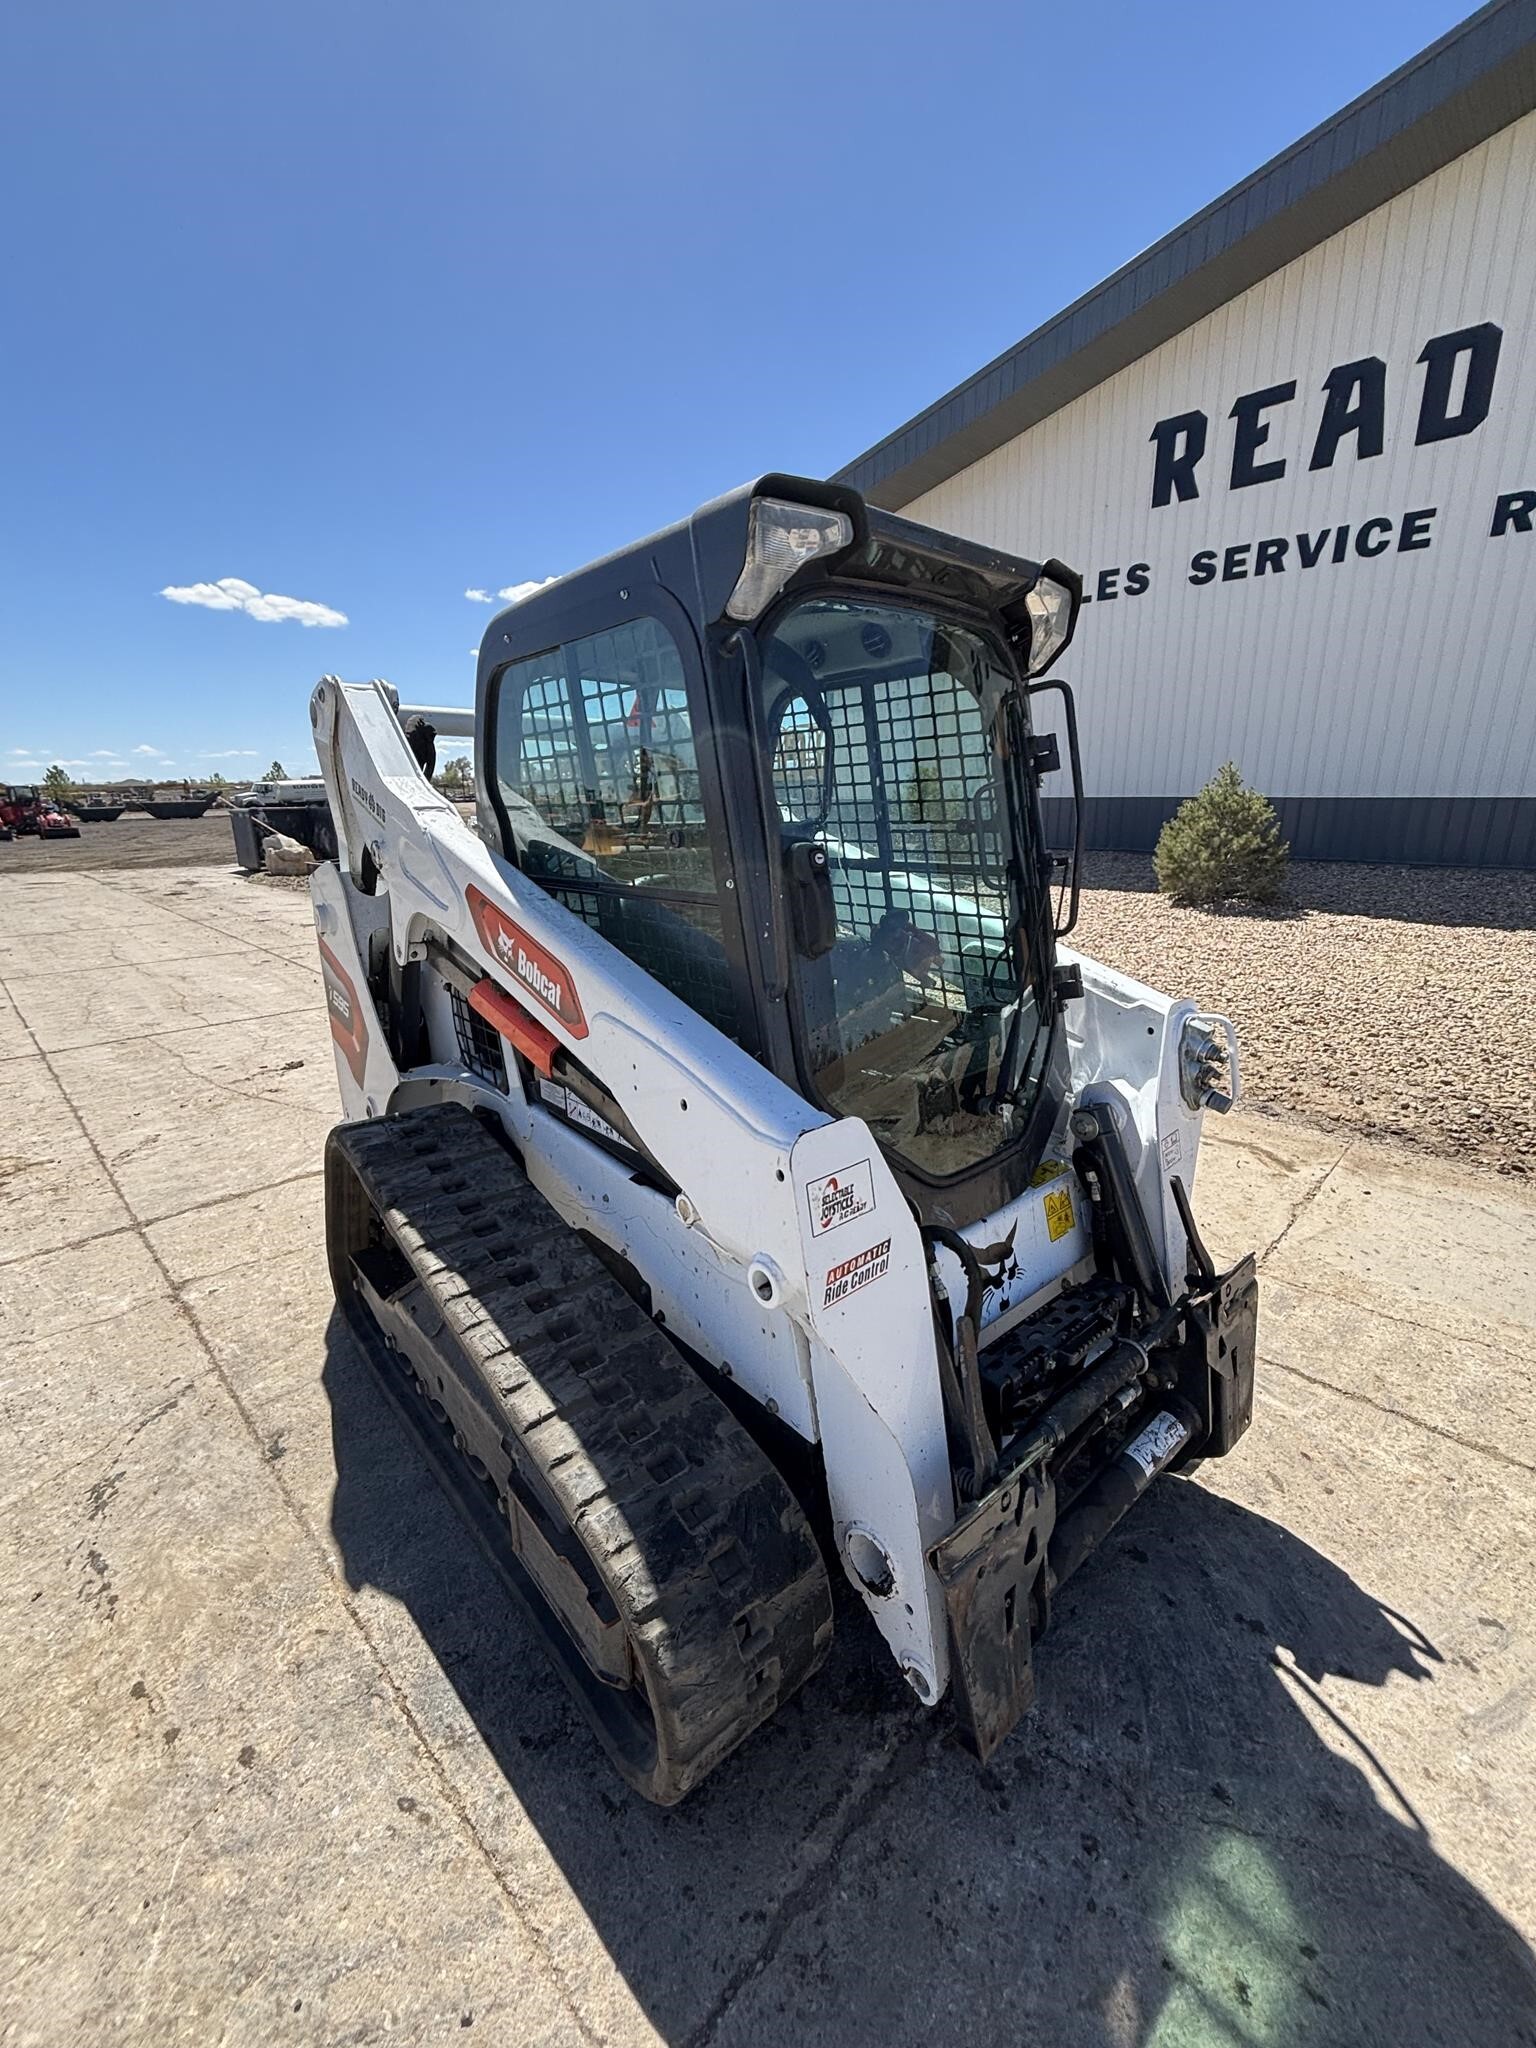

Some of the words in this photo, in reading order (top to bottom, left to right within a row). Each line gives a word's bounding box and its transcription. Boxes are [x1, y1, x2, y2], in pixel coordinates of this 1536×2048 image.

[1148, 321, 1504, 510] READ
[1188, 508, 1437, 587] SERVICE
[517, 947, 561, 1011] Bobcat
[820, 1194, 854, 1221] JOYSTICKS
[823, 1279, 849, 1306] Ride
[850, 1253, 890, 1290] Control
[827, 1241, 890, 1286] AUTOMATIC
